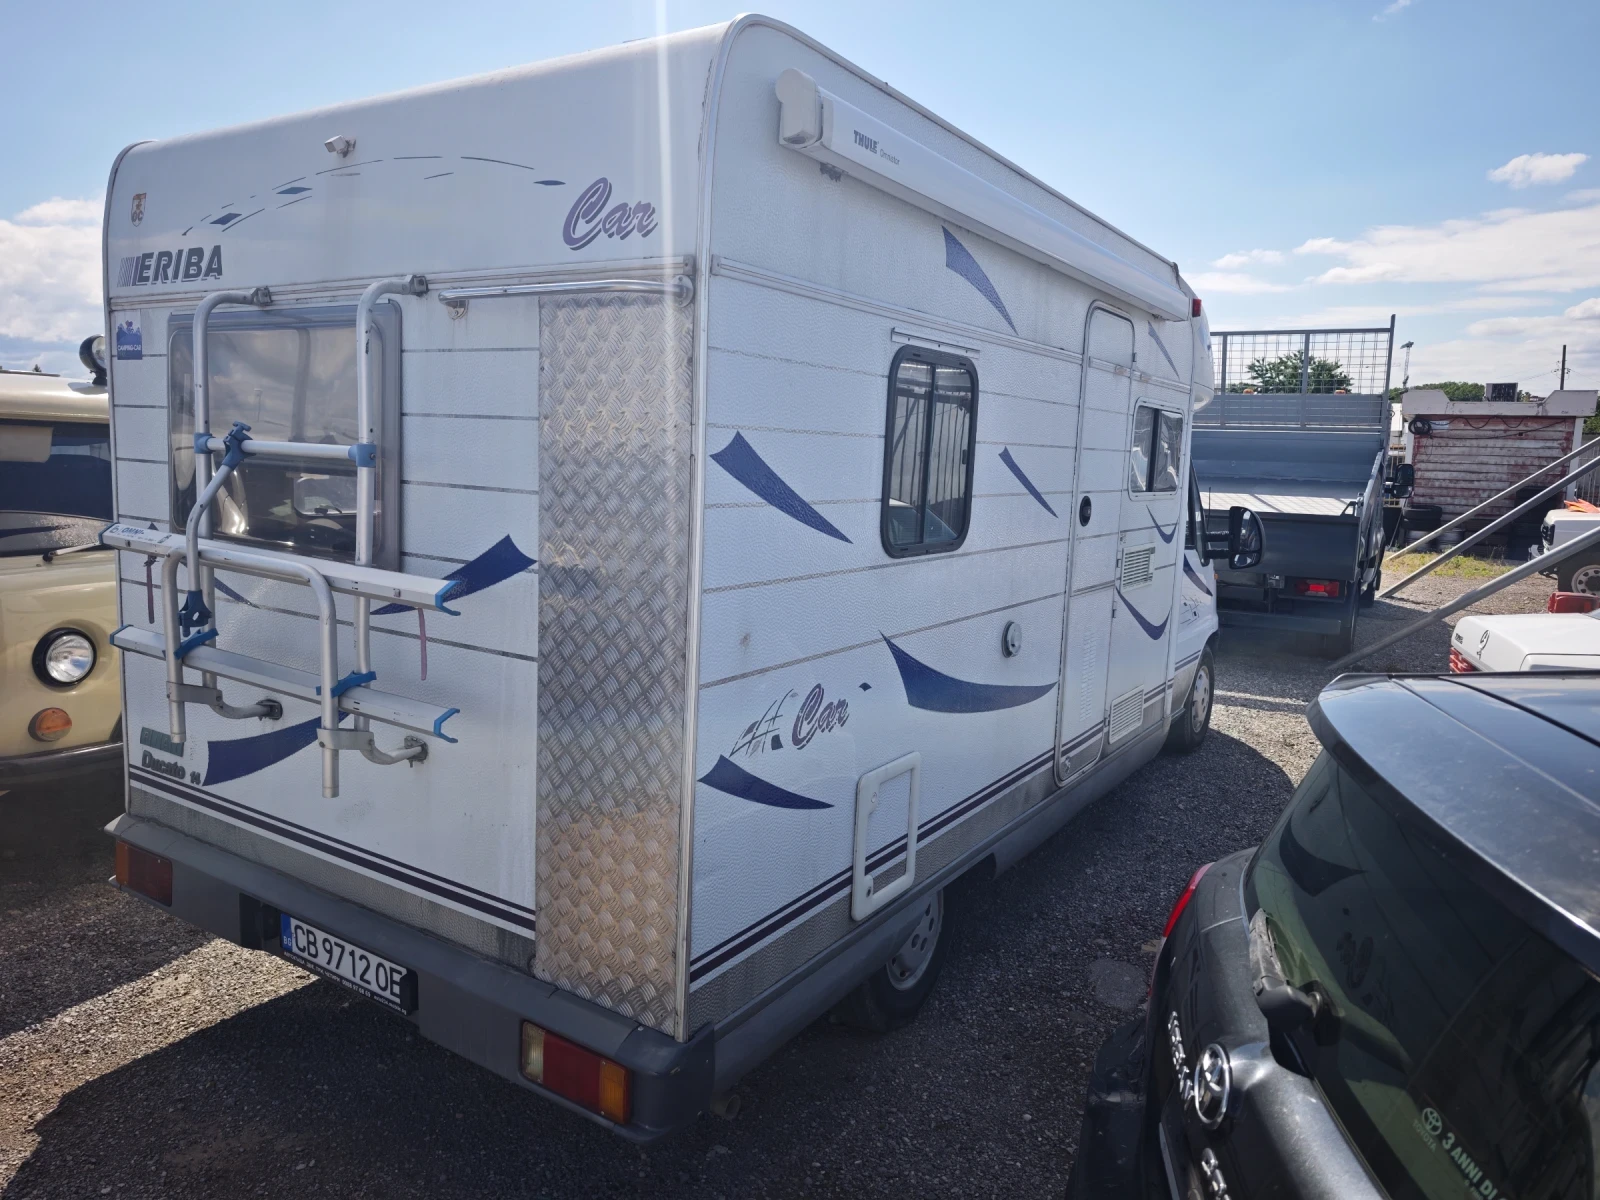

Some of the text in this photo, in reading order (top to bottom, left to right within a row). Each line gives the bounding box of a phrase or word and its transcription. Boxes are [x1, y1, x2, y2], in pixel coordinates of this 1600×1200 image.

[853, 129, 878, 154] THULE
[562, 176, 658, 251] Car
[132, 244, 223, 287] ERIBA
[791, 683, 850, 750] Car
[141, 749, 187, 780] Ducato
[283, 935, 292, 947] BG
[1442, 1132, 1455, 1150] 3
[1450, 1146, 1483, 1183] ANNI
